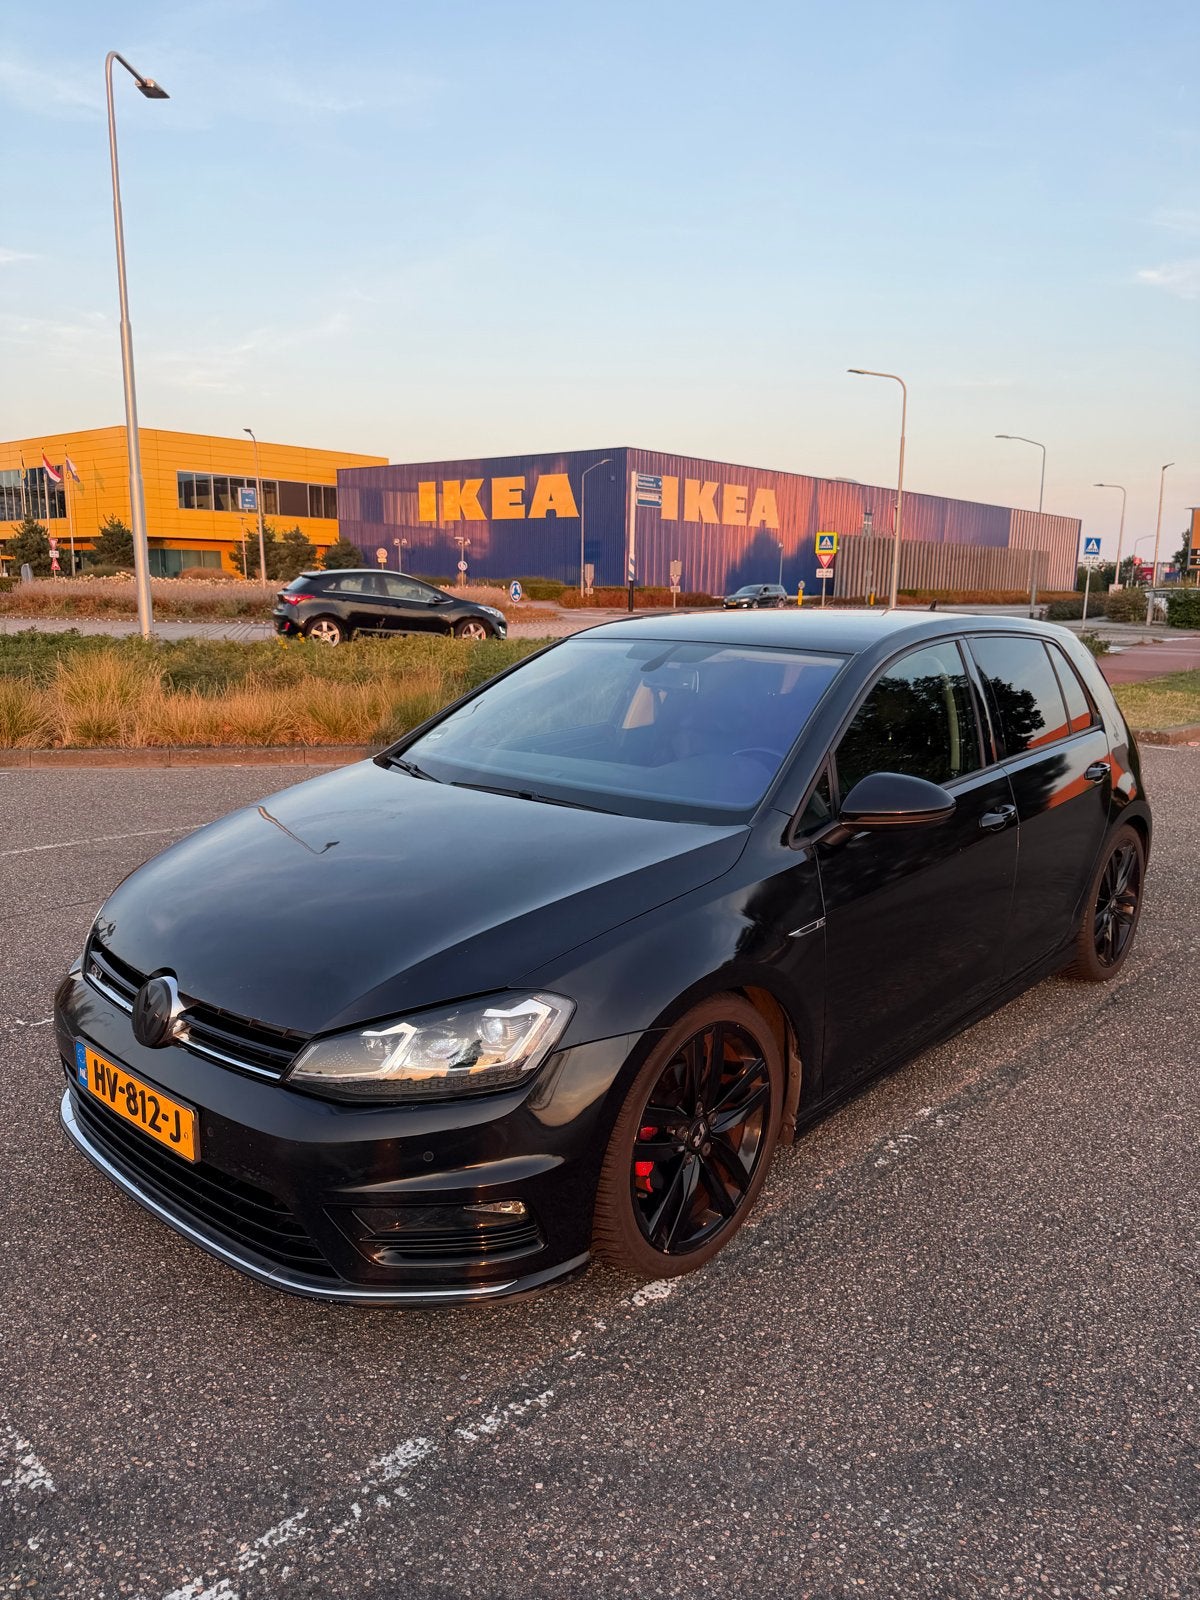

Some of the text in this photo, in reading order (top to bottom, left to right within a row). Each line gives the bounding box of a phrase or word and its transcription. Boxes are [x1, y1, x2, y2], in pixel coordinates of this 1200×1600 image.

[418, 473, 580, 521] IKEA
[661, 475, 780, 528] IKEA
[94, 1059, 181, 1143] HV-812-J
